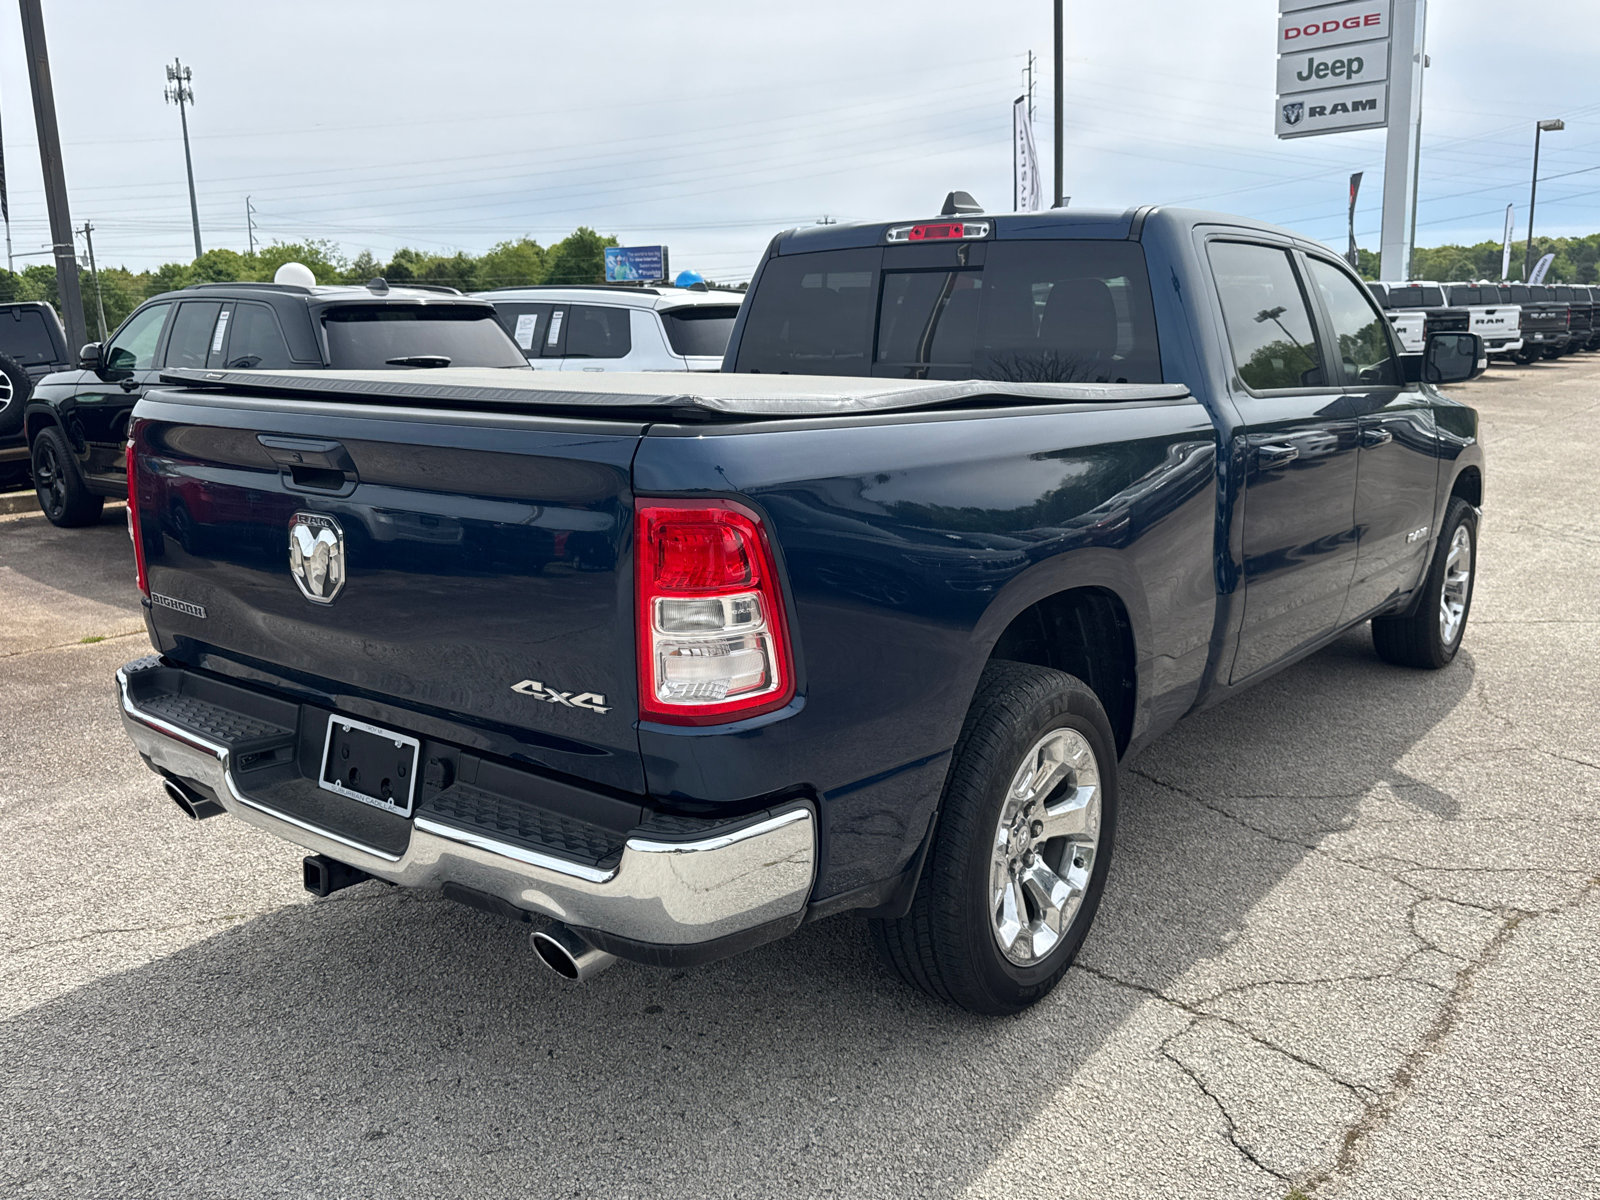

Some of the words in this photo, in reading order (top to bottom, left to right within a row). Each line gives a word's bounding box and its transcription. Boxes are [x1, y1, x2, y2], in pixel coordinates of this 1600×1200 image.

[1284, 13, 1381, 40] DODGE
[1296, 56, 1364, 81] Jeep
[1308, 98, 1377, 118] RAM
[297, 514, 329, 527] RAM
[152, 593, 204, 618] BIGHORN
[331, 785, 365, 801] SUBURBAN
[365, 796, 398, 812] CADILLAC
